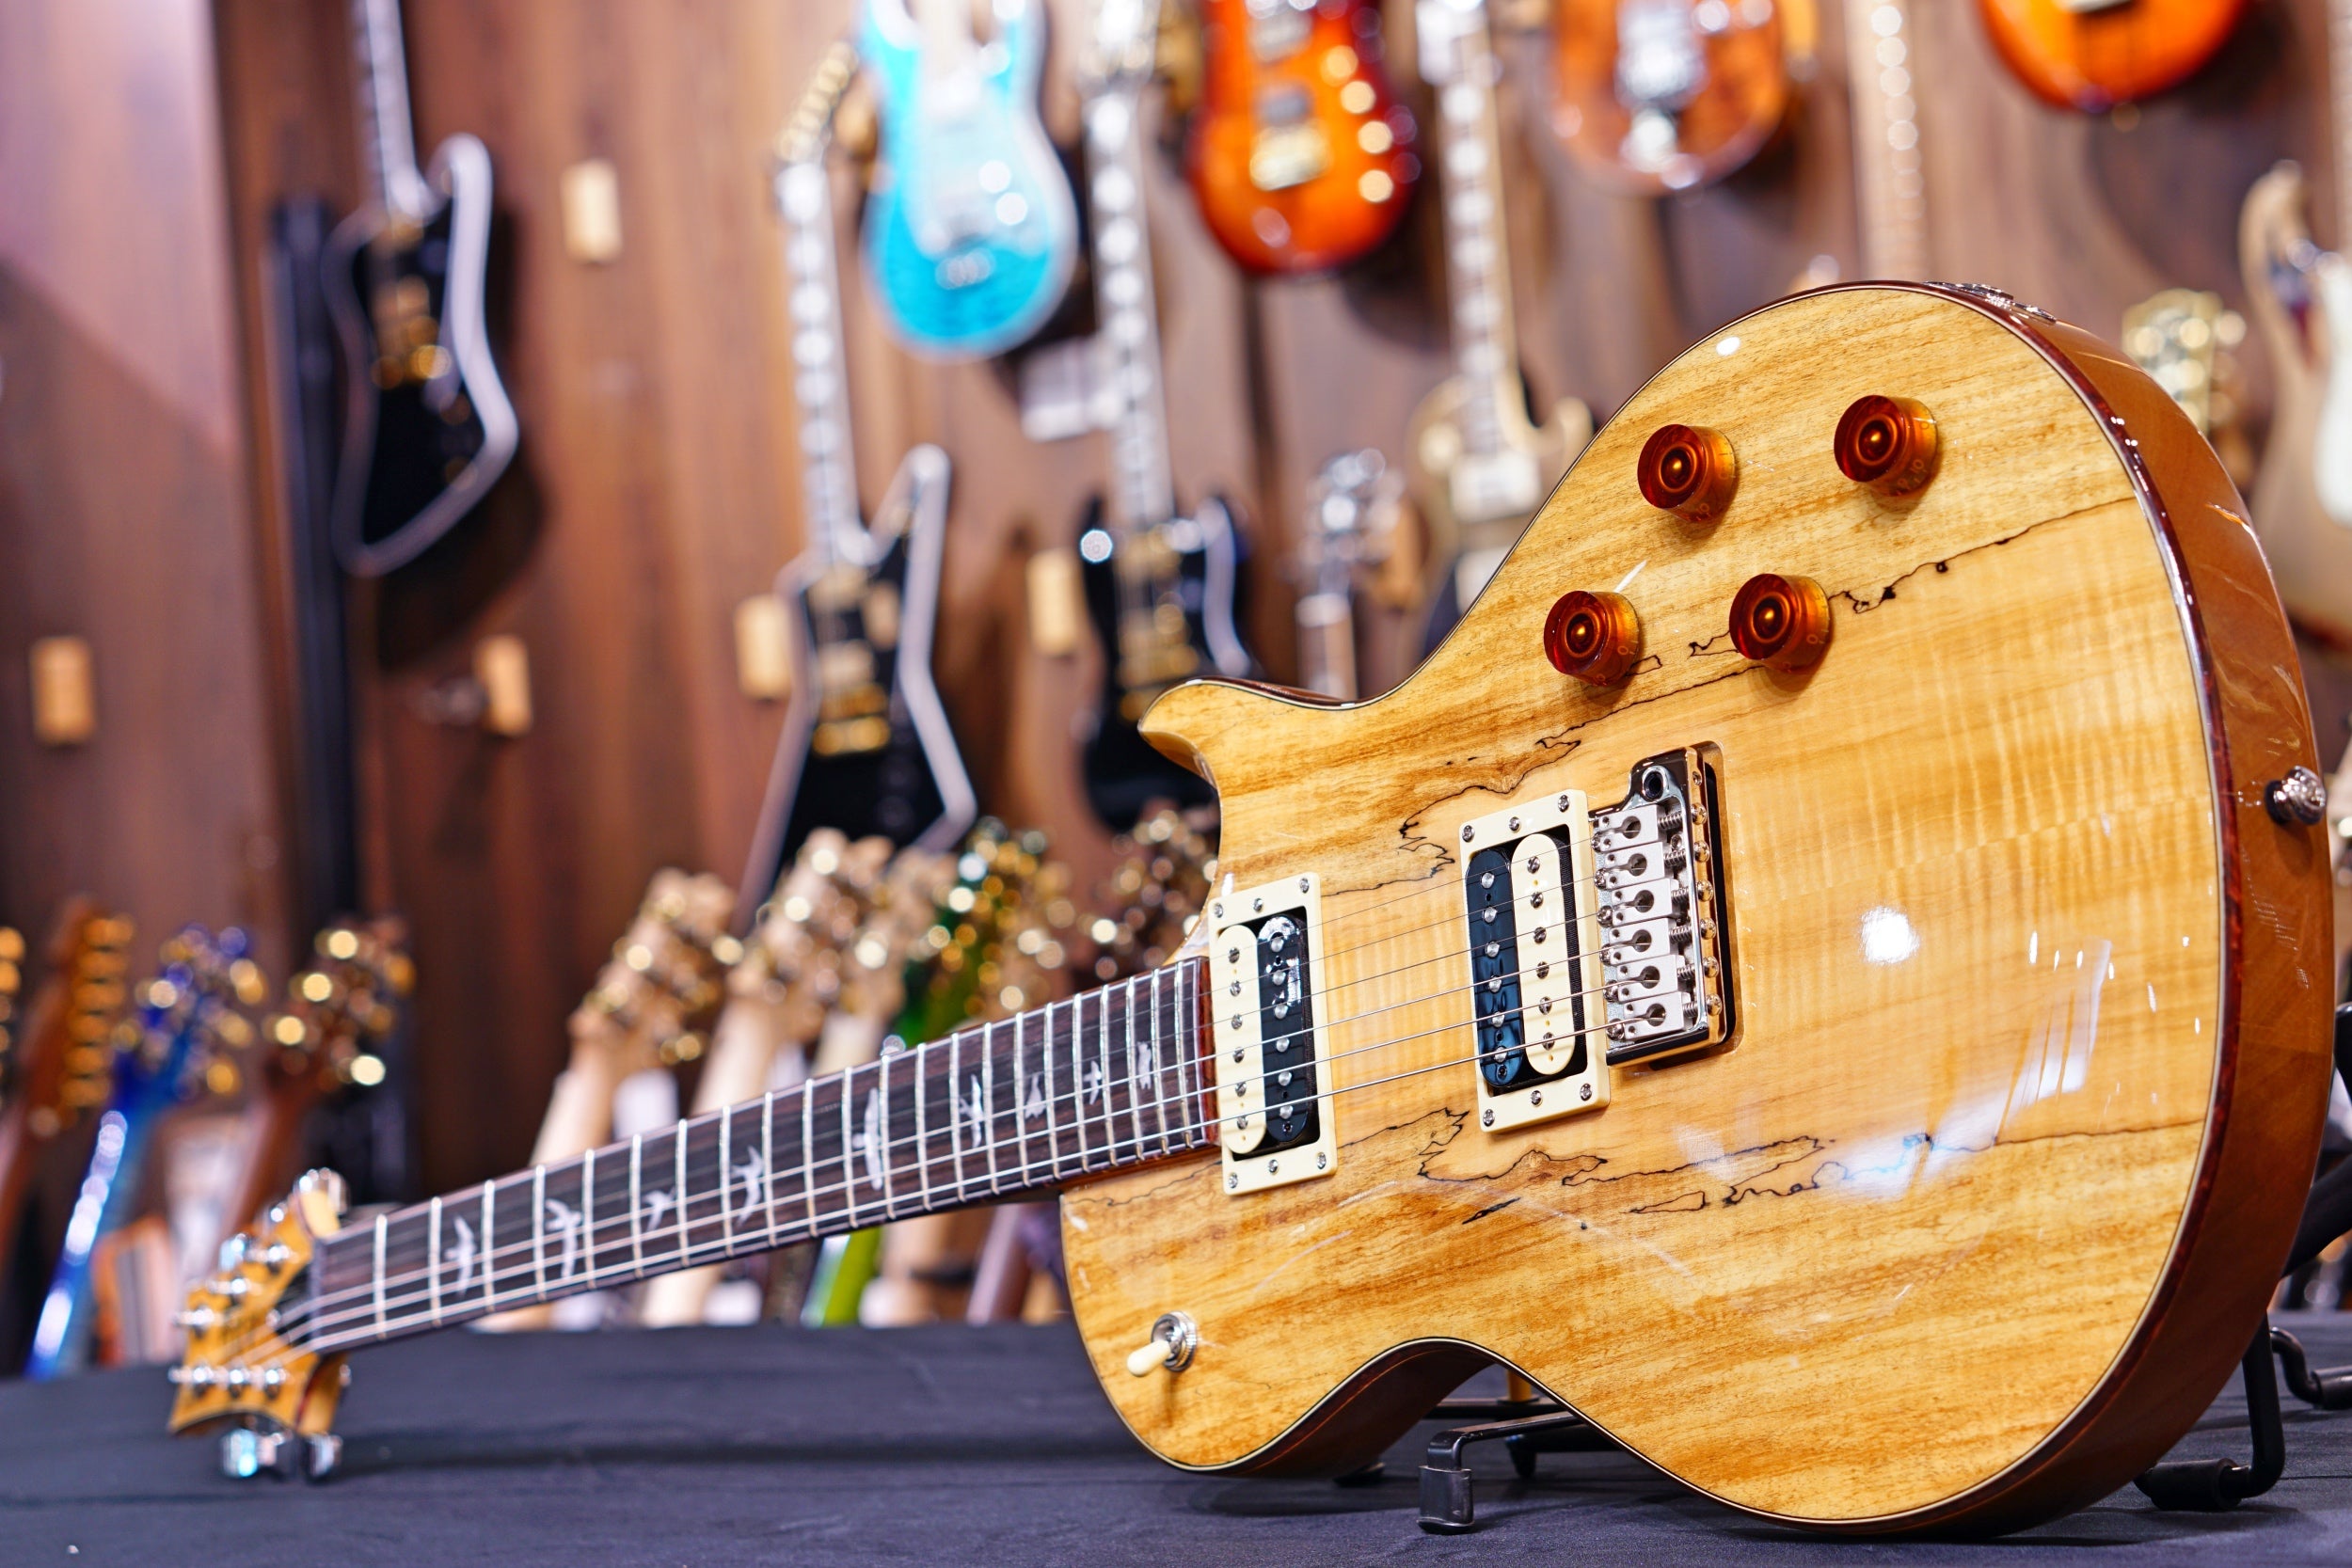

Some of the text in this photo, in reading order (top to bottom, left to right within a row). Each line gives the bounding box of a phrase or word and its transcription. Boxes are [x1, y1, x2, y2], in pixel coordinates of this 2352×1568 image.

[1909, 458, 1925, 475] 10
[1805, 633, 1819, 645] 0
[1617, 645, 1629, 656] 0
